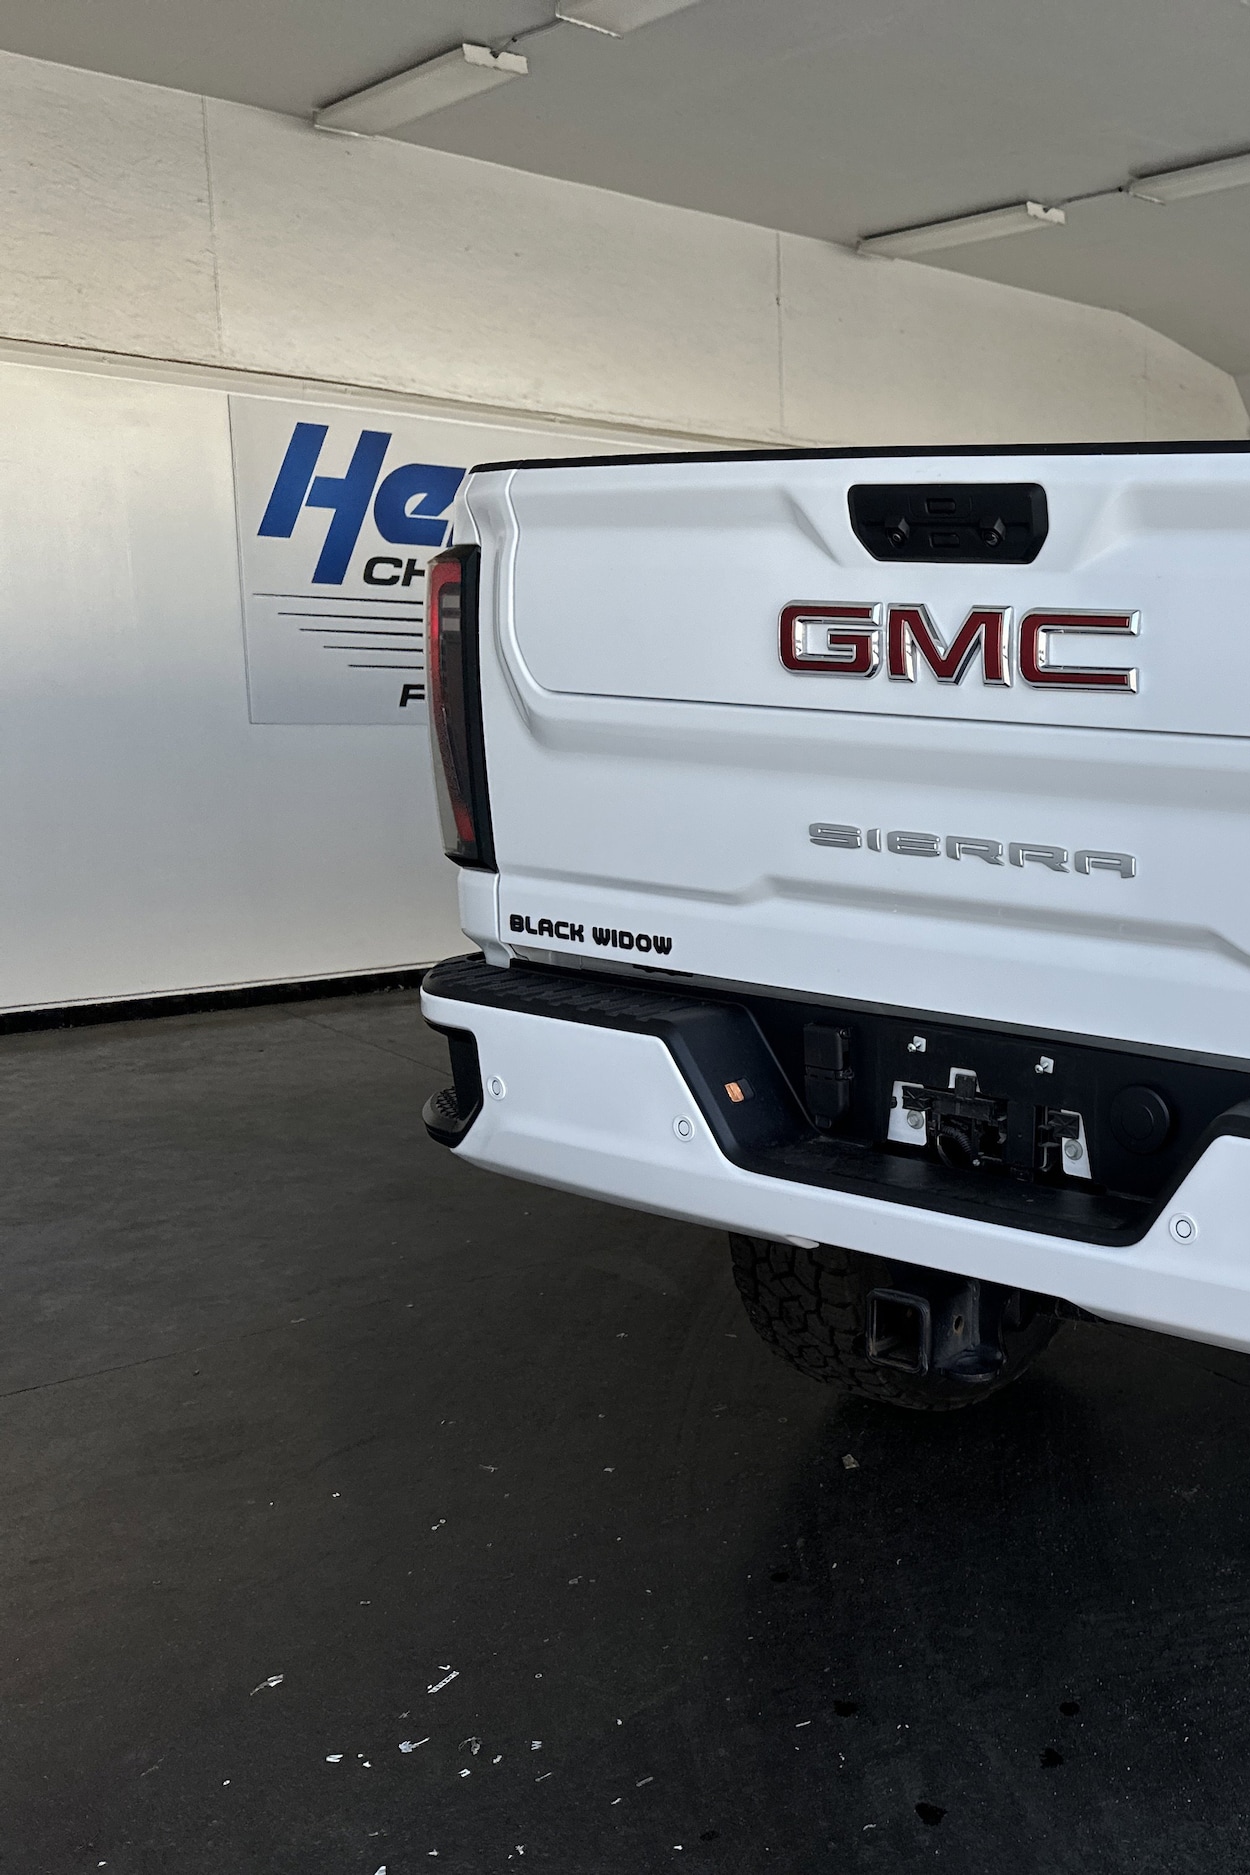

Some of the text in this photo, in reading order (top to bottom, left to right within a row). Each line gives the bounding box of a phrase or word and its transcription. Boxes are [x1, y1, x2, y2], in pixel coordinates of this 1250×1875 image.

[257, 421, 467, 585] He
[777, 599, 1140, 695] GMC
[808, 822, 1137, 879] SIERRA
[509, 914, 673, 955] BLACK WIDOW
